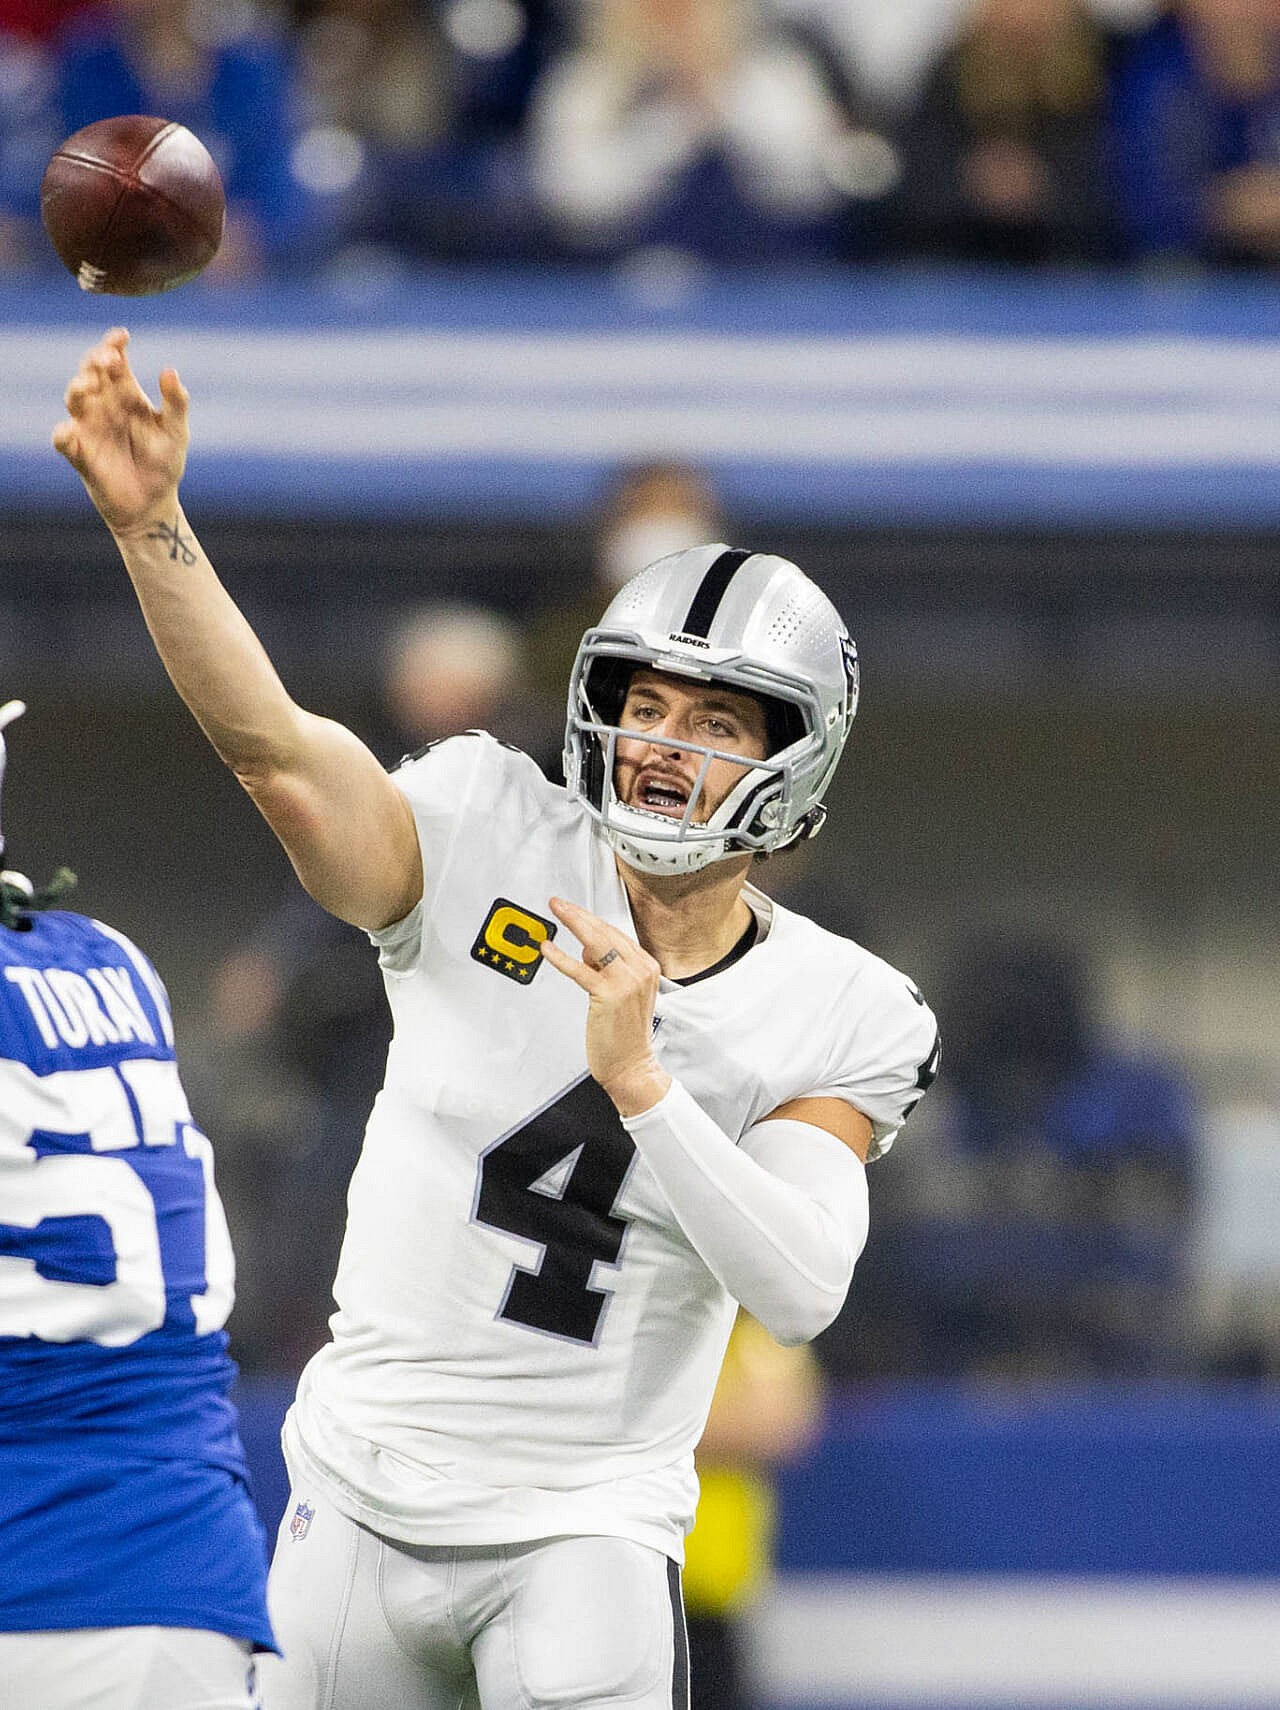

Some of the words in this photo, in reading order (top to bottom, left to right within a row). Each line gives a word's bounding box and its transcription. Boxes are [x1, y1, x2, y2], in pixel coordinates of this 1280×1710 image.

[668, 633, 711, 649] RAIDERS
[484, 906, 548, 964] C
[470, 1069, 639, 1349] 4
